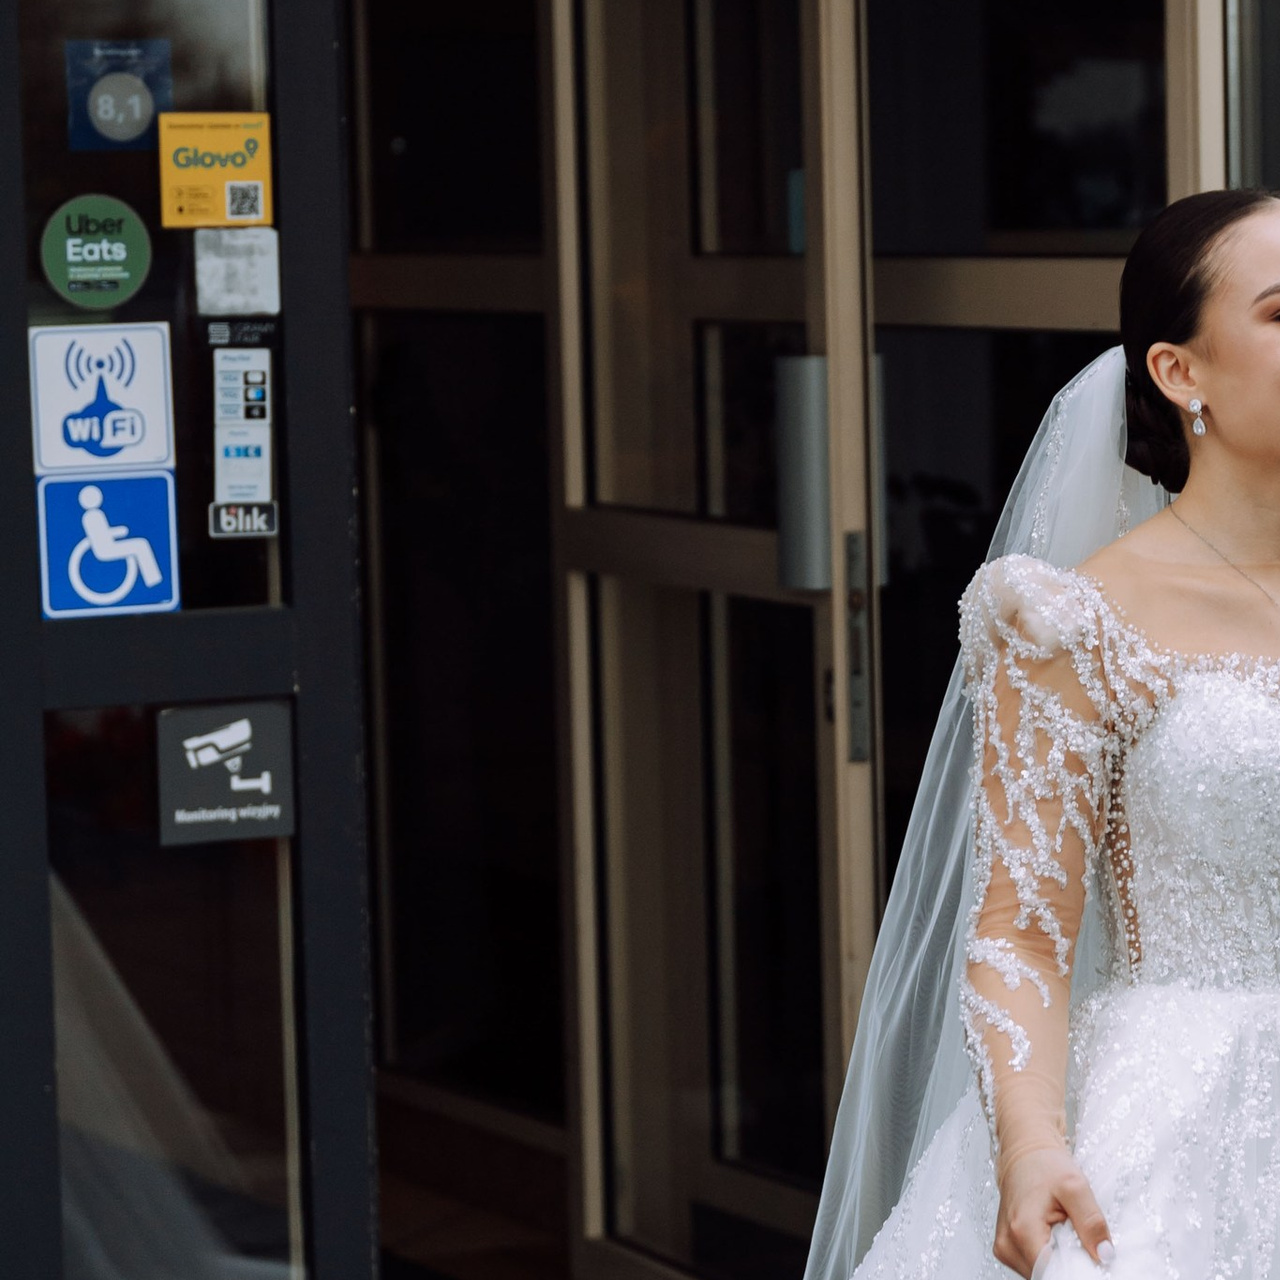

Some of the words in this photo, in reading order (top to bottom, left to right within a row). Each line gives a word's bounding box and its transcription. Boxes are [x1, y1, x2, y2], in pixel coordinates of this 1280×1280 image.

[97, 93, 142, 123] 8,1
[172, 146, 247, 169] Glovo
[65, 213, 125, 236] Uber
[66, 237, 128, 262] Eats
[219, 505, 268, 533] blik
[174, 806, 238, 824] Monitoring
